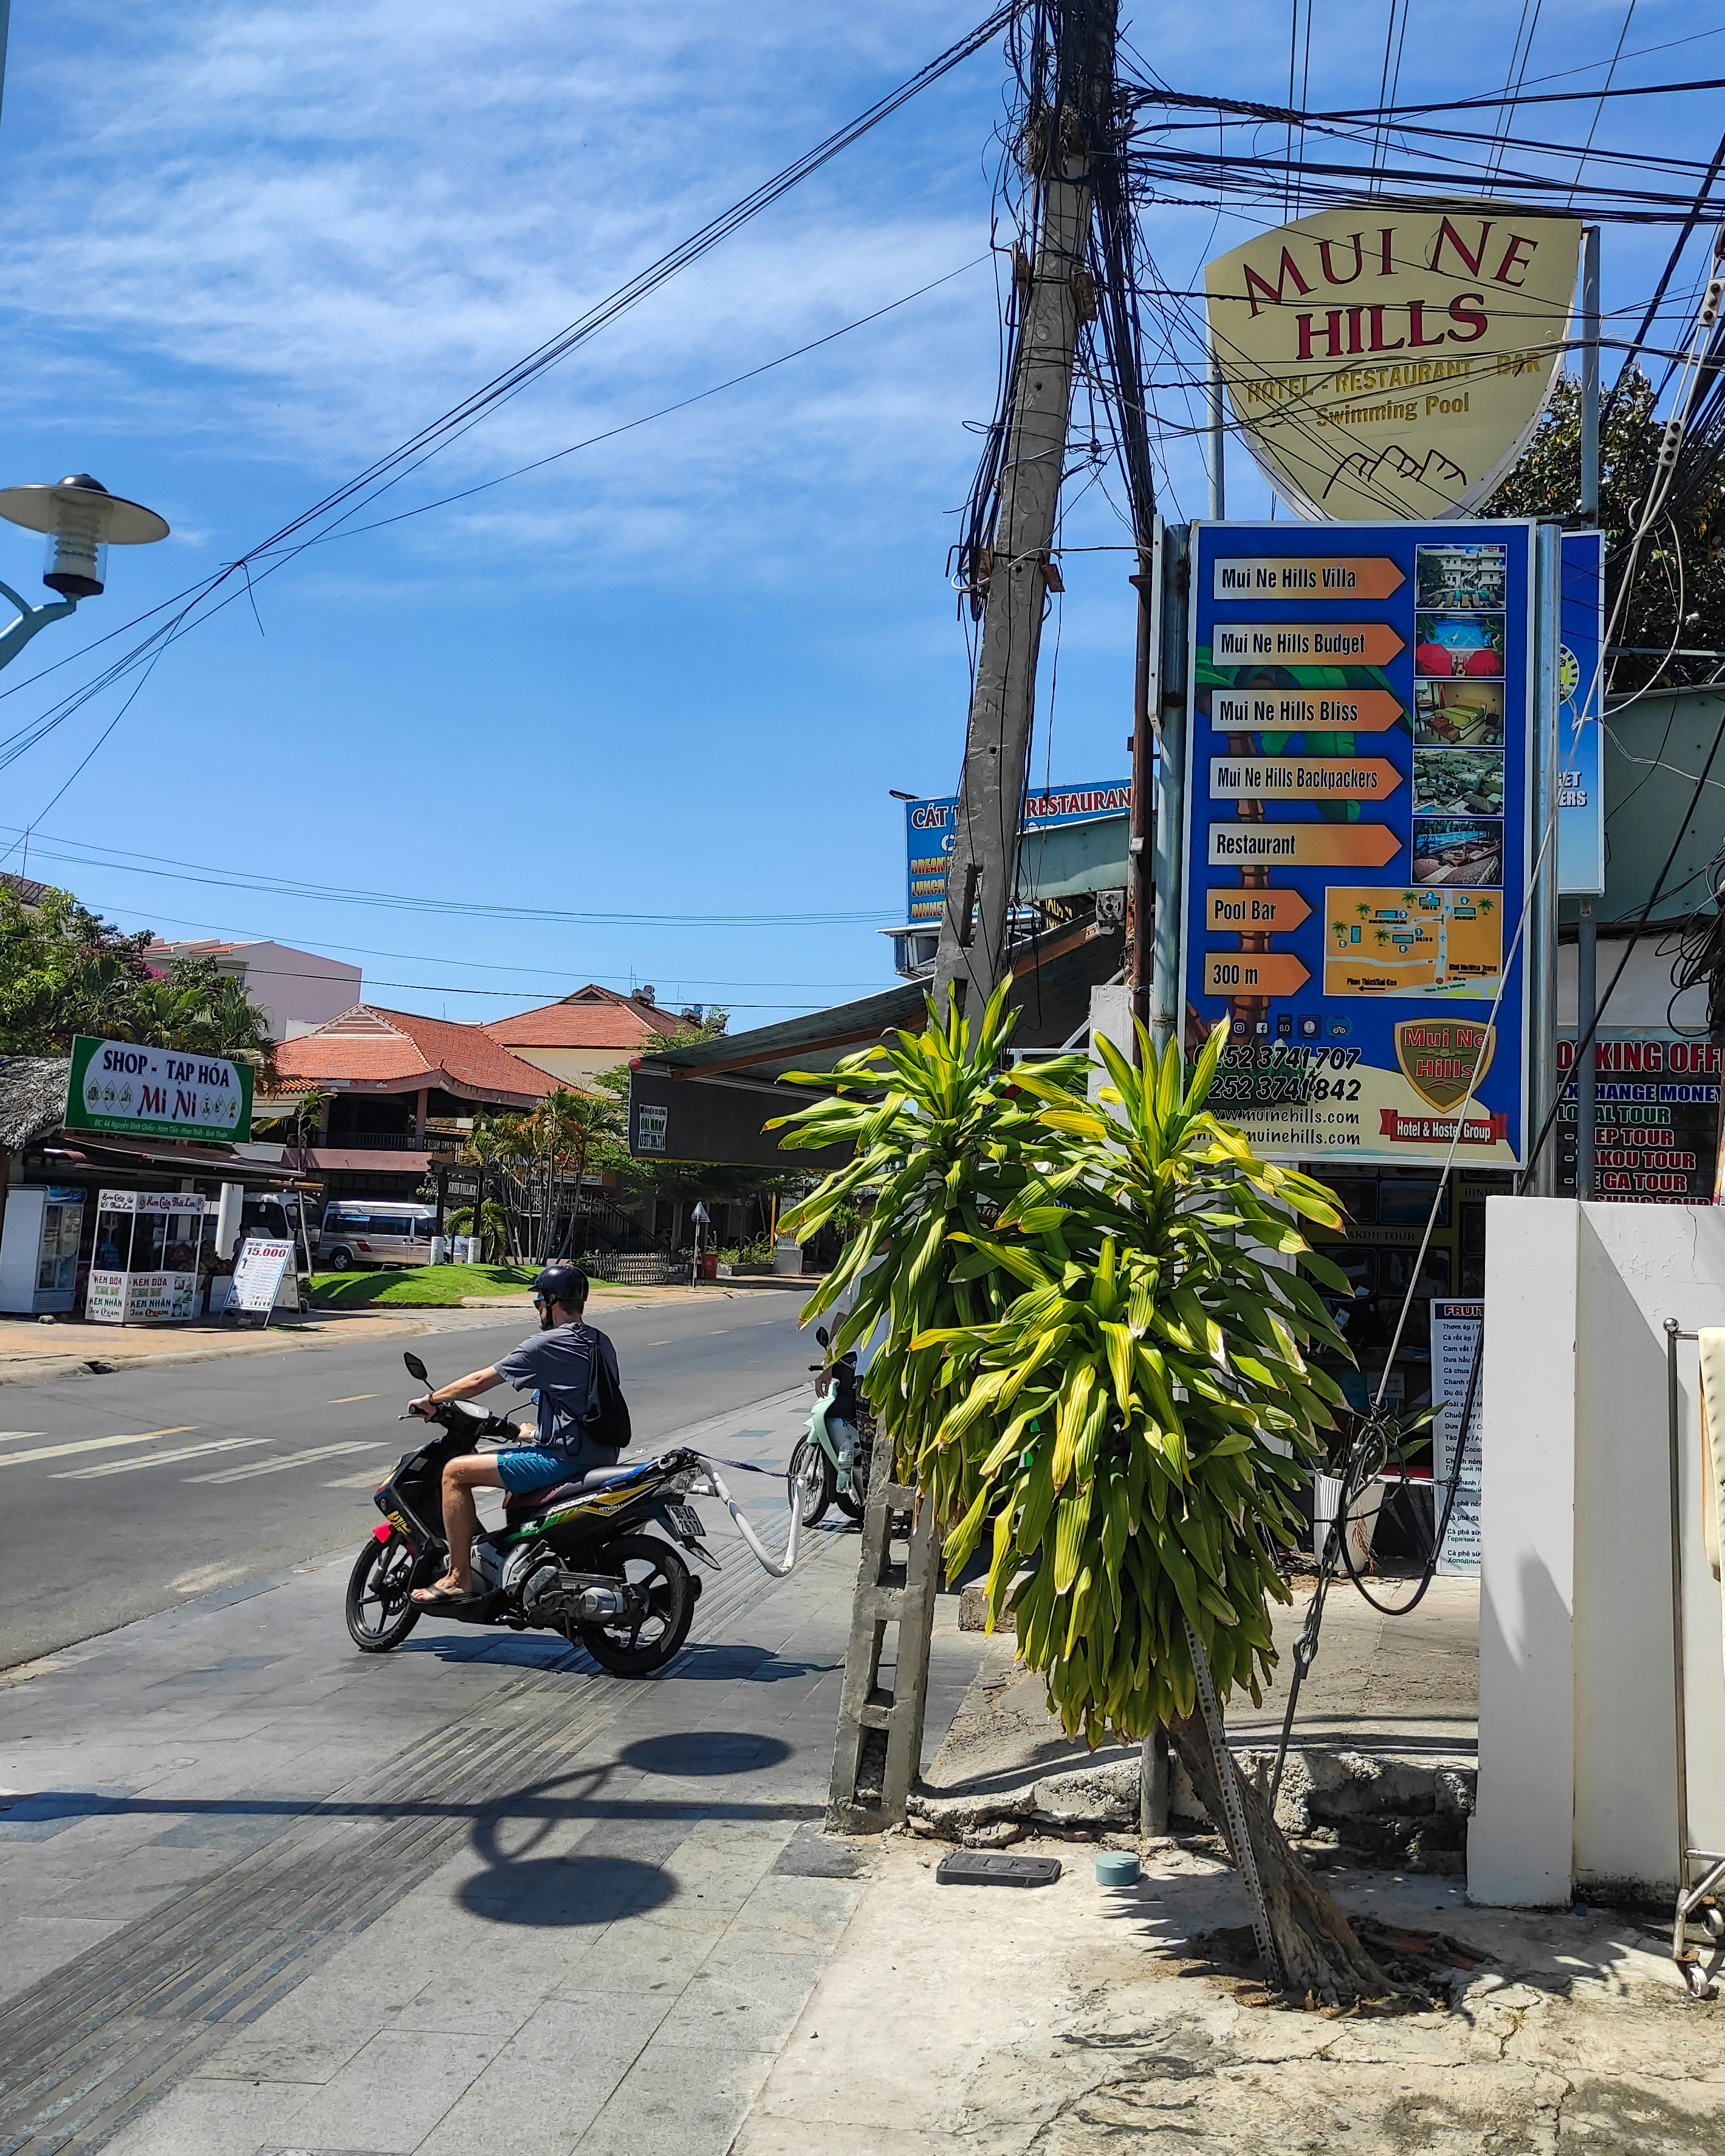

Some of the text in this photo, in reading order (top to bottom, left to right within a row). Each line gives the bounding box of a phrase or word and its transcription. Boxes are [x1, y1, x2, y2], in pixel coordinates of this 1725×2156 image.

[1243, 216, 1539, 319] MUI NE
[1296, 293, 1489, 360] HILLS
[1247, 376, 1312, 404] HOTEL
[1336, 360, 1473, 394] RESTAURANT
[1497, 352, 1542, 377] BAR
[1316, 392, 1469, 427] Swimming Pool
[1221, 567, 1356, 589] Mui Ne Hills Villa
[1221, 633, 1365, 656] Mui Ne Hills Budget
[1219, 700, 1358, 722] Mui Ne Hills Bliss
[1217, 767, 1378, 791] Mui Ne Hills Backpackers
[912, 803, 948, 829] CÁT
[1216, 833, 1296, 856] Restaurant
[1214, 900, 1277, 921] Pool Bar
[1213, 964, 1258, 985] 300 m
[1404, 1028, 1487, 1048] Mui Ne
[1257, 1045, 1311, 1070] 3741
[1315, 1046, 1361, 1071] 707
[1557, 1040, 1662, 1071] OKING
[103, 1049, 148, 1076] SHOP
[166, 1059, 194, 1085] TẠP
[198, 1063, 230, 1088] HÓA
[1416, 1060, 1475, 1078] Hills
[1207, 1075, 1362, 1101] 252 3741 842
[1557, 1083, 1658, 1102] EXHANGE
[137, 1085, 197, 1121] Mi Ni
[1557, 1104, 1670, 1124] LOAL TOUR
[1397, 1121, 1420, 1137] Hotel
[1422, 1122, 1430, 1137] &
[1464, 1122, 1491, 1142] Group
[1620, 1128, 1674, 1147] TOUR
[1576, 1149, 1640, 1169] AKOU
[1642, 1152, 1696, 1170] TOUR
[1603, 1172, 1632, 1191] GA
[1633, 1173, 1687, 1192] TOUR
[1384, 1231, 1415, 1241] TOUR
[247, 1247, 286, 1258] 15.000
[94, 1275, 107, 1284] KEM
[132, 1278, 149, 1286] KEM
[89, 1297, 103, 1306] KEM
[130, 1300, 147, 1308] KEM
[101, 1308, 120, 1318] Cream
[145, 1308, 170, 1317] Cream
[677, 1519, 701, 1534] 2617
